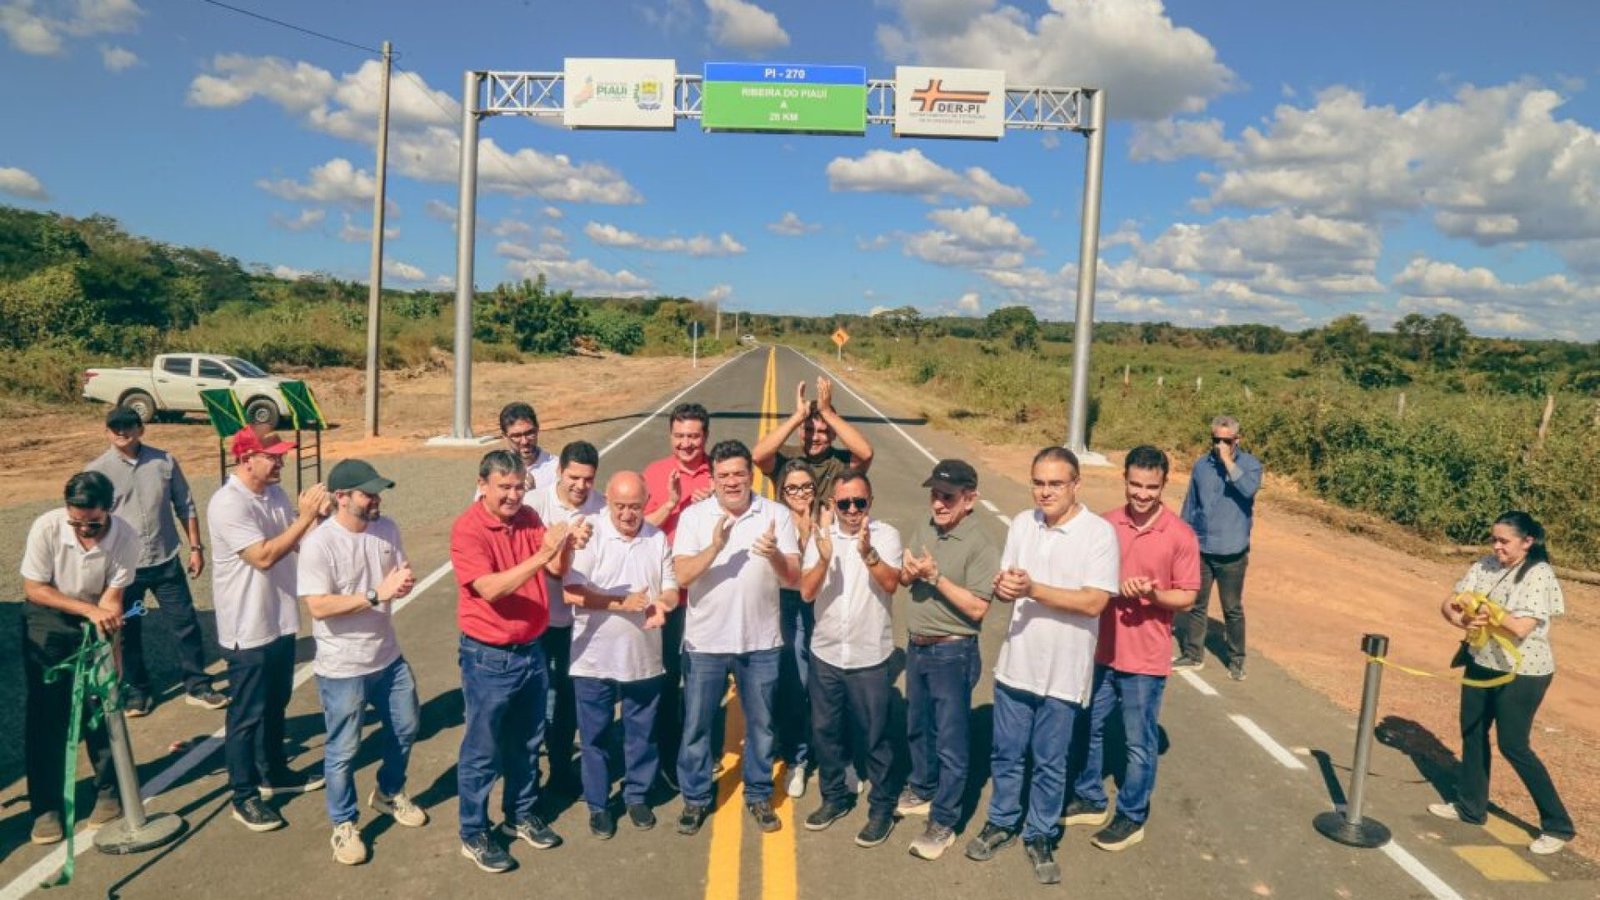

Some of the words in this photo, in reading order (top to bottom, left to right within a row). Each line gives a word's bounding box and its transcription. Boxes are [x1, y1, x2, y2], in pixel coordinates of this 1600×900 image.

[765, 68, 776, 79] PI
[785, 69, 805, 79] 270
[741, 87, 781, 97] RIBEIRA
[784, 88, 799, 98] DO
[780, 101, 788, 109] A
[938, 103, 980, 113] DER-PI
